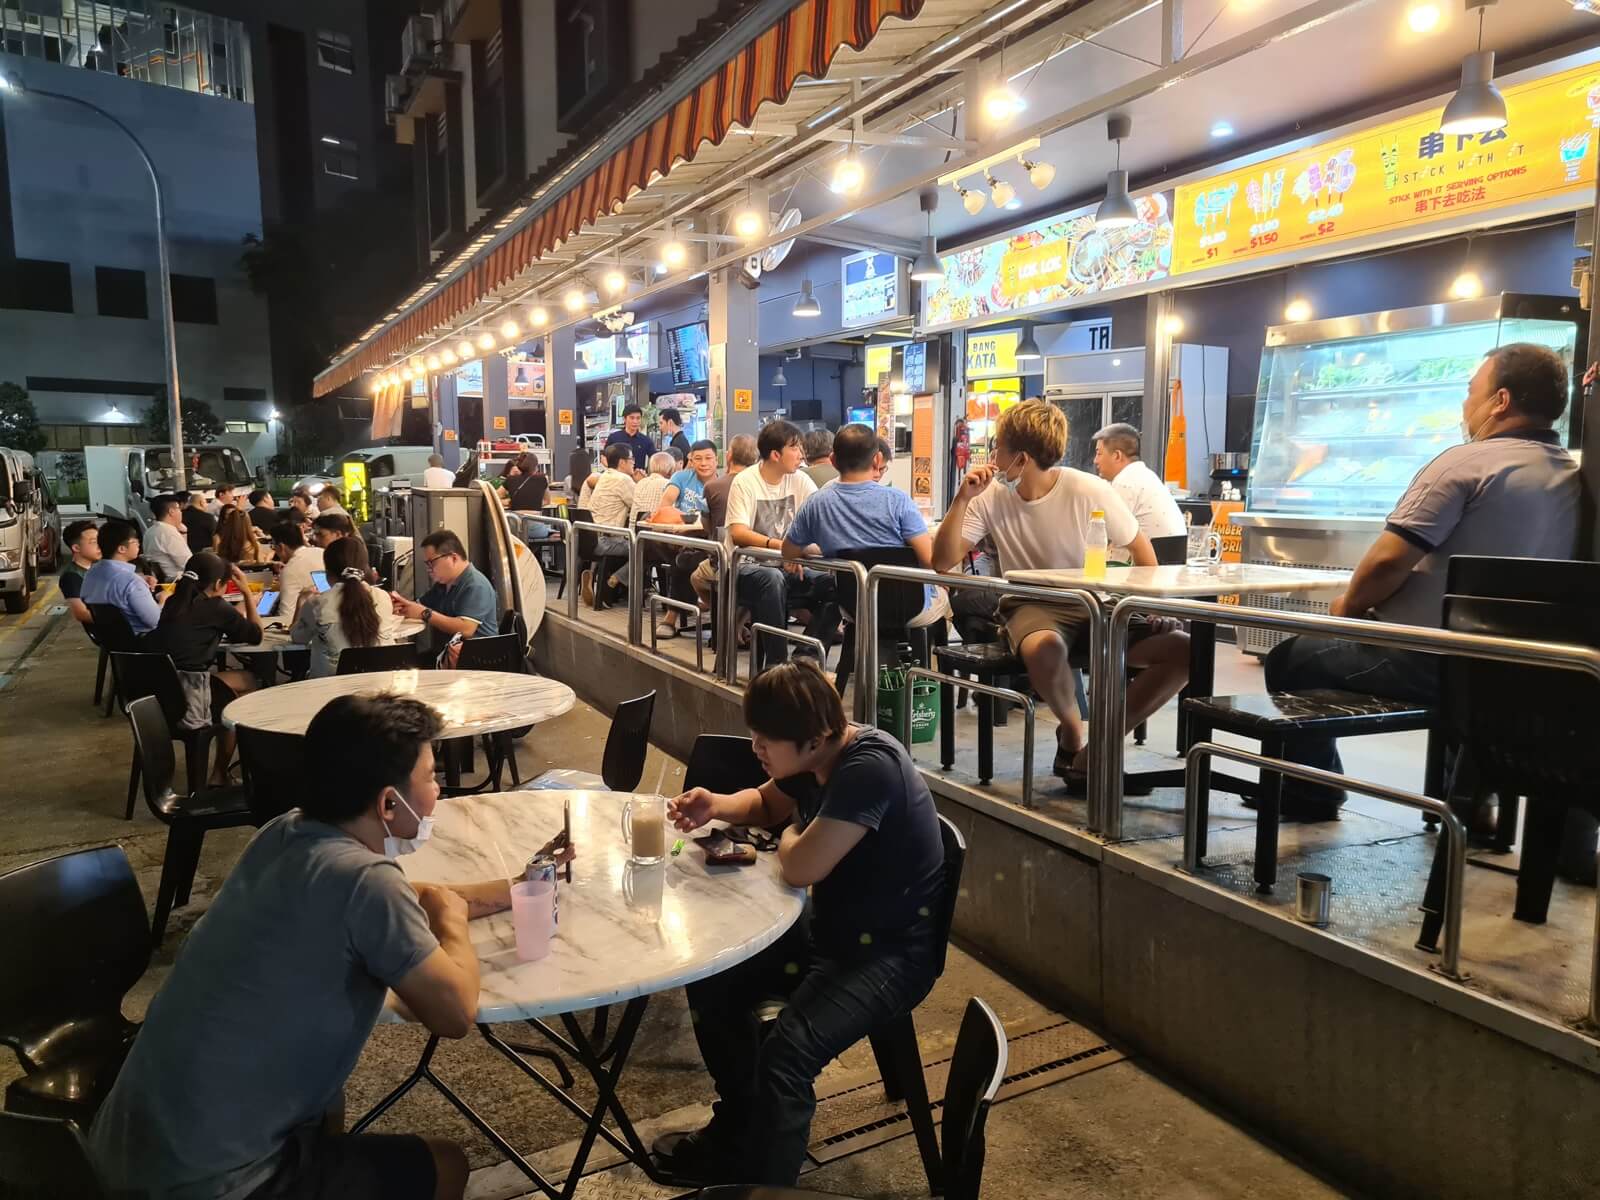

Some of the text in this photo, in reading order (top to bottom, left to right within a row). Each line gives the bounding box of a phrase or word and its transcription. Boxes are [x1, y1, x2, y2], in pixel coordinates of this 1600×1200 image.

[1388, 166, 1527, 205] STICK WITH IT SERVING OPTIONS
[1415, 186, 1486, 213] 串下去吃法
[1317, 221, 1336, 236] $2
[1250, 232, 1279, 249] $1.50
[1206, 247, 1219, 259] $1
[973, 340, 996, 352] BANG
[1088, 326, 1110, 351] TA
